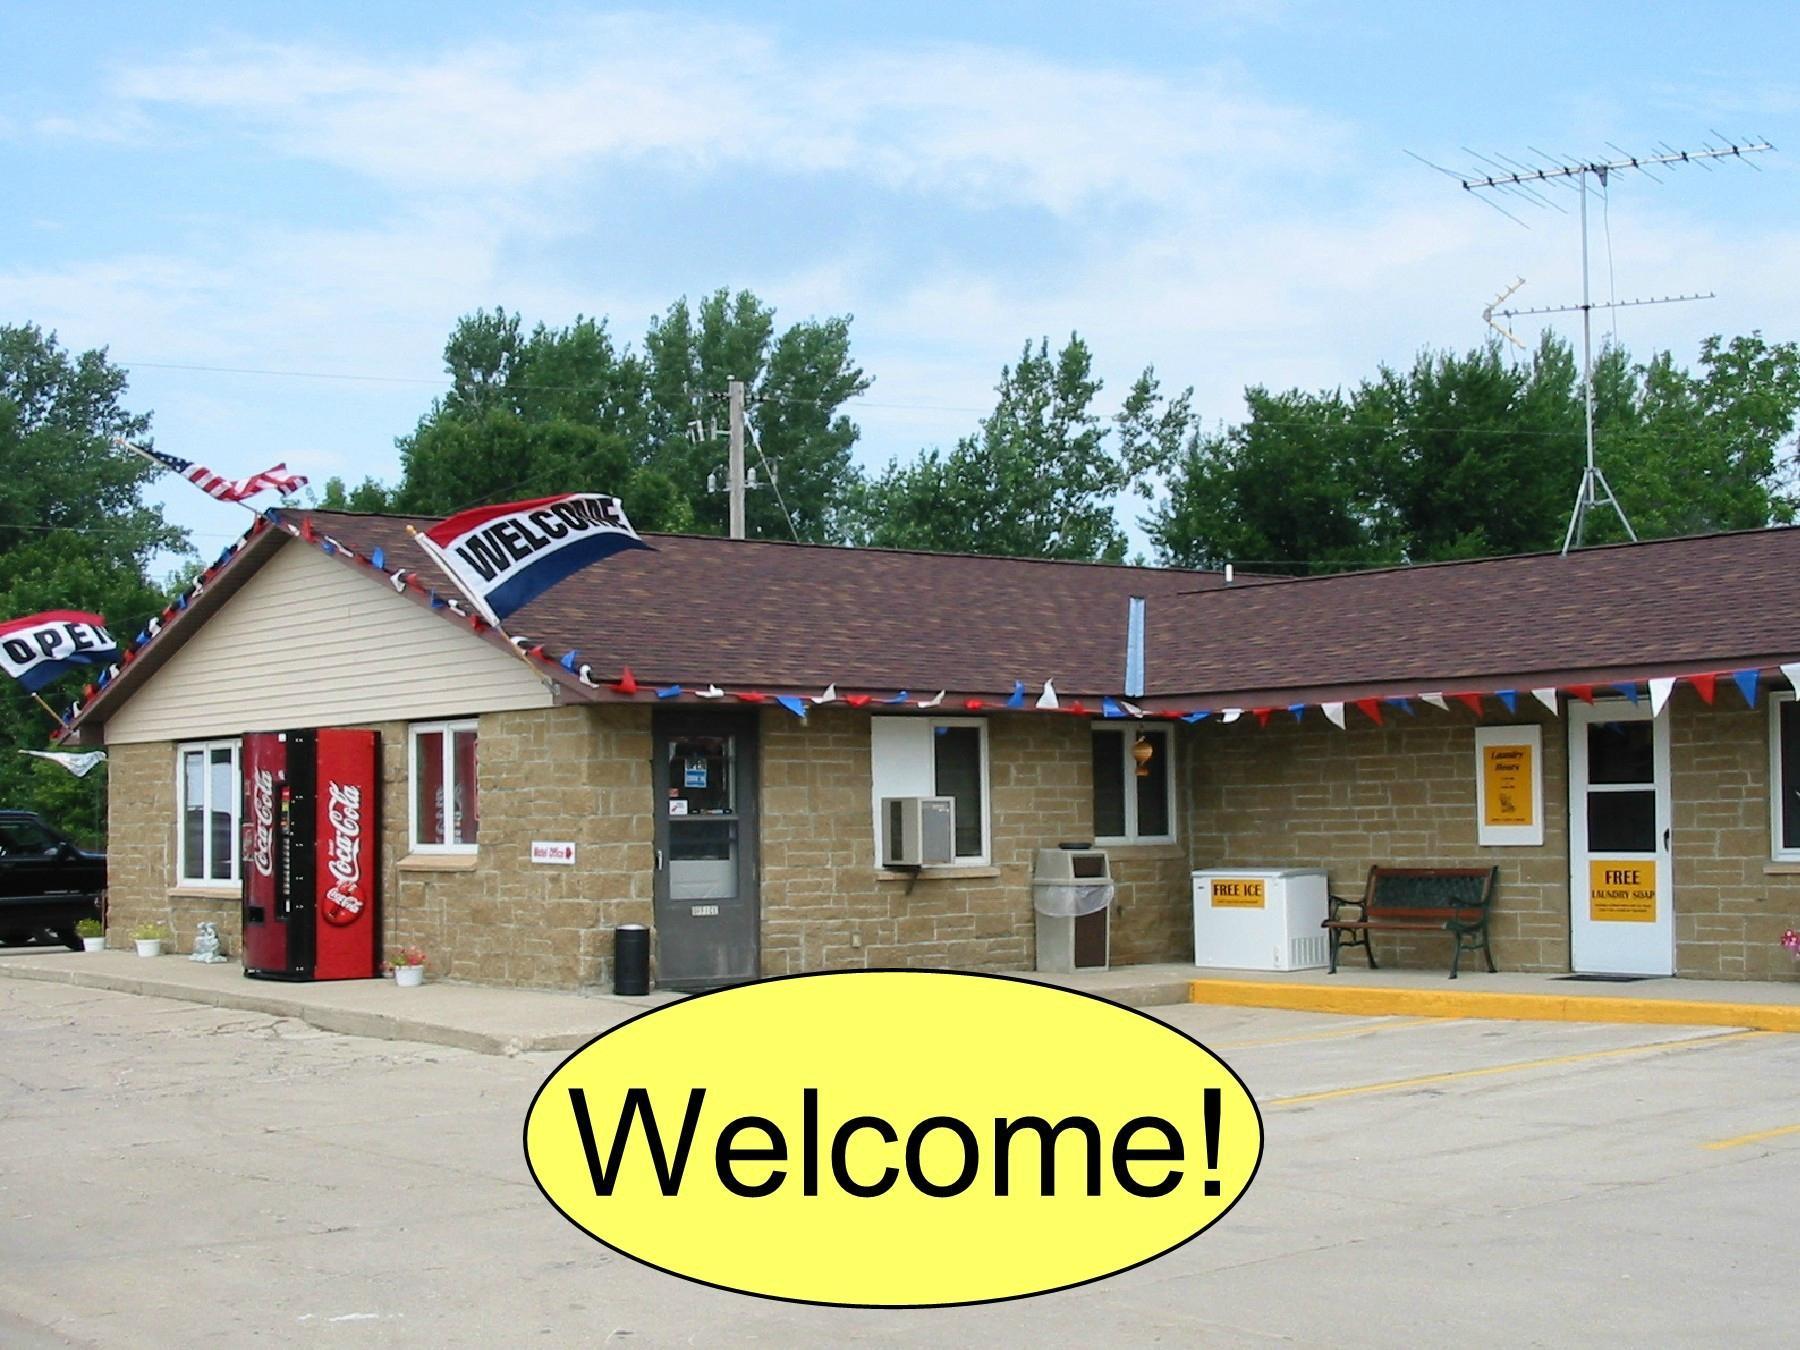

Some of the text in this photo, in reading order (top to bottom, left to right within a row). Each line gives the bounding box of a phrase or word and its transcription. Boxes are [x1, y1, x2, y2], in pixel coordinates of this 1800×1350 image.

[455, 498, 628, 582] WELCOME
[1605, 869, 1641, 885] FREE
[1213, 884, 1262, 896] FREE ICE
